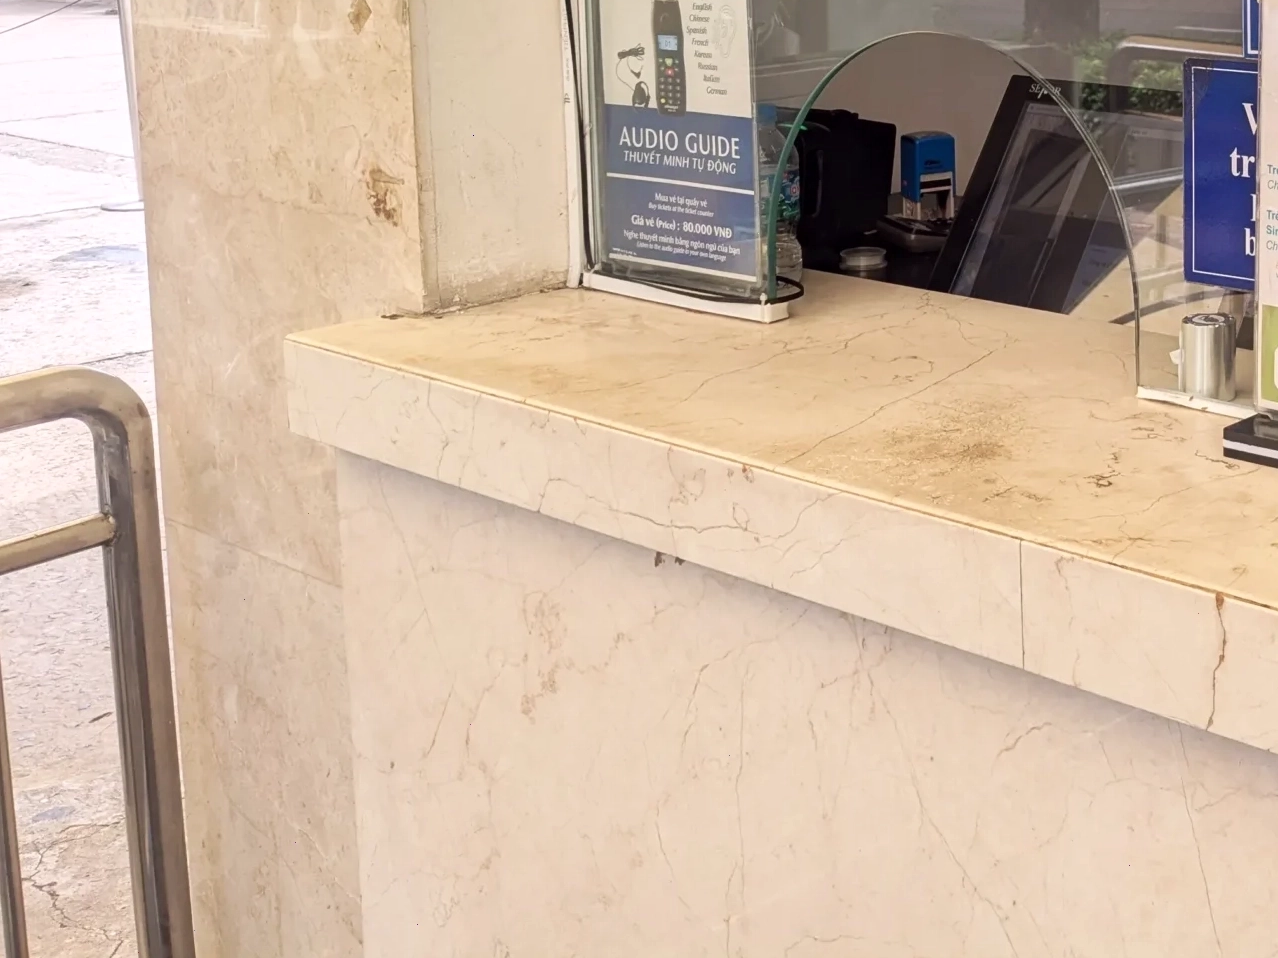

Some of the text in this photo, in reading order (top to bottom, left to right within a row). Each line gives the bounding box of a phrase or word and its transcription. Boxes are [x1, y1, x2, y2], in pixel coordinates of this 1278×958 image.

[619, 126, 740, 159] AUDIO GUIDE
[624, 150, 736, 174] THUYẾT MINH TỰ ĐỘNG
[655, 193, 668, 202] Mua
[631, 215, 644, 225] Giá
[645, 217, 654, 227] vé
[683, 222, 712, 235] 80.000
[624, 229, 638, 240] Nghe
[659, 234, 674, 244] minh
